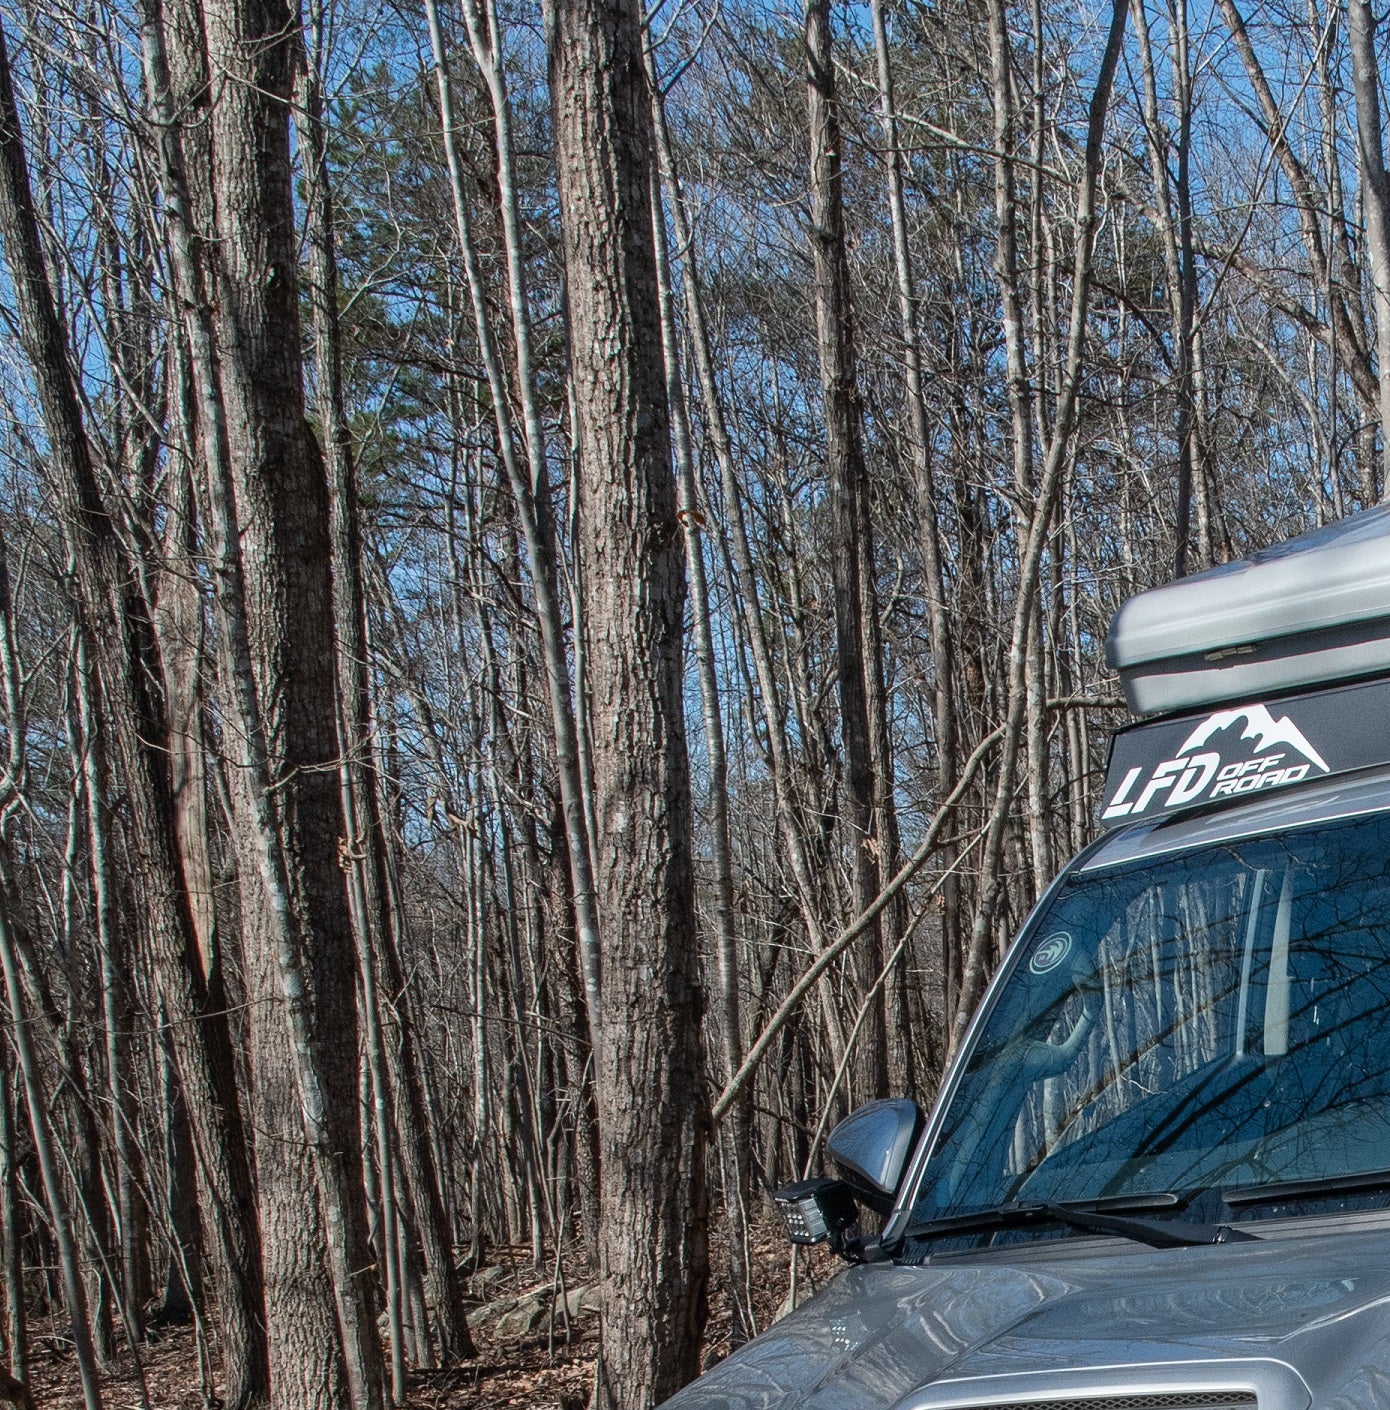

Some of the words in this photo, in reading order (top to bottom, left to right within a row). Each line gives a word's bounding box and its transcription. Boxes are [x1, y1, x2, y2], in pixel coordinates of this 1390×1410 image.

[1209, 764, 1311, 799] ROAD
[1216, 753, 1286, 782] OFF
[1101, 752, 1221, 820] LFD
